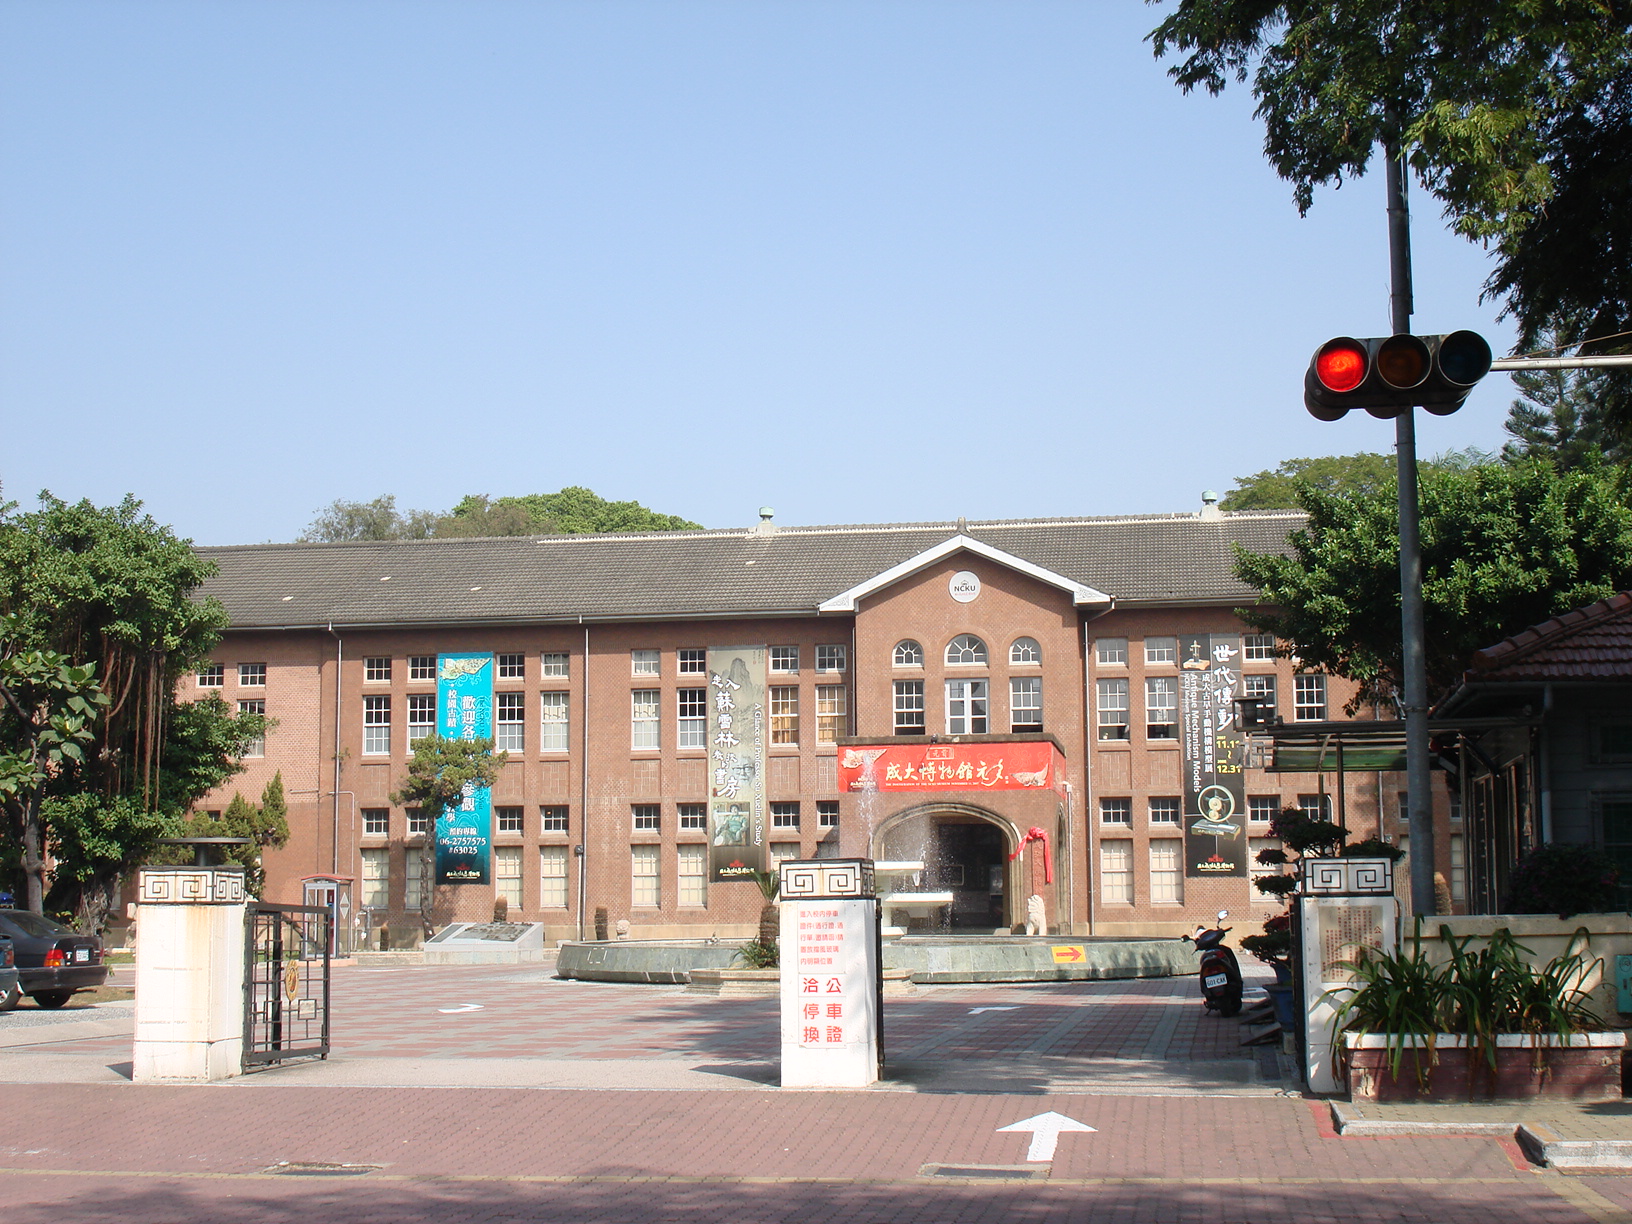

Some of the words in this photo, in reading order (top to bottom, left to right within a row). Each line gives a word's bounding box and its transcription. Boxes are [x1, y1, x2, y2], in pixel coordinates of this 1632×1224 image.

[1190, 674, 1198, 708] Antique
[1212, 644, 1239, 732] 世代傳動
[755, 738, 762, 746] of
[1191, 710, 1200, 758] Mechanism
[1193, 761, 1201, 793] Models
[755, 782, 762, 791] Su
[440, 837, 487, 846] 06-2757575
[754, 825, 763, 847] Study
[449, 846, 478, 854] #63025
[803, 977, 842, 993] 洽公
[803, 1003, 843, 1020] 停車
[803, 1026, 843, 1043] 換證
